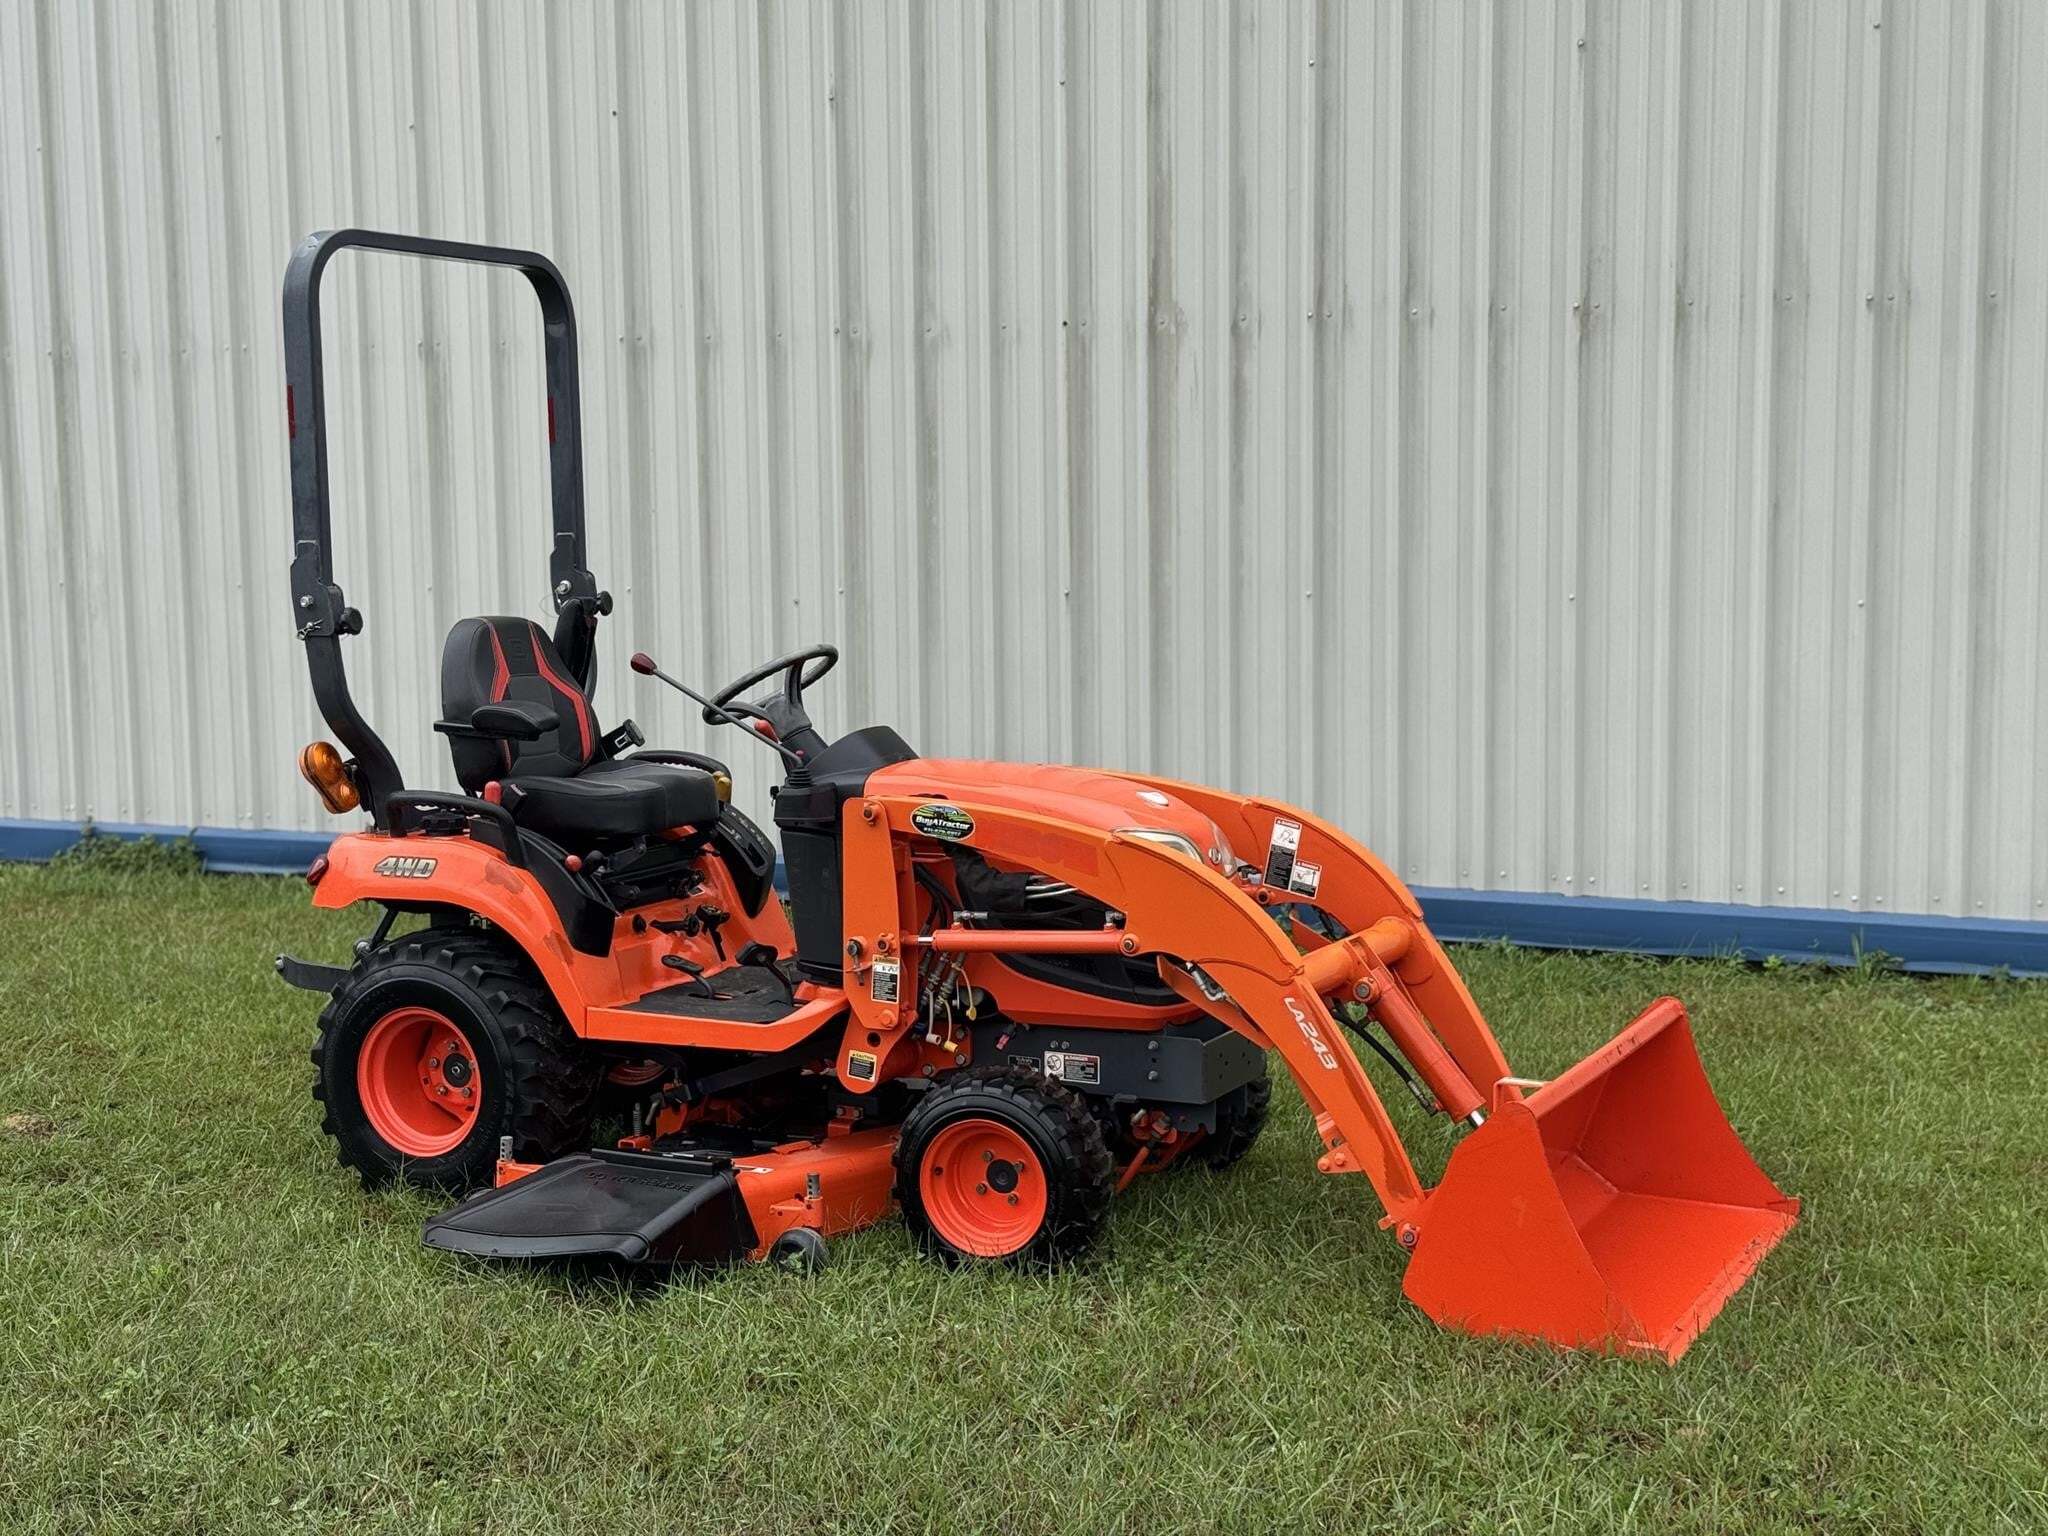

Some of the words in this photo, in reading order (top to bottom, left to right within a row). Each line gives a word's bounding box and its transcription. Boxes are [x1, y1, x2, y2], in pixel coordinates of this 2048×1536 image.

[915, 815, 971, 830] BuyATractor
[374, 856, 437, 878] 4WD
[1284, 997, 1338, 1070] LA243
